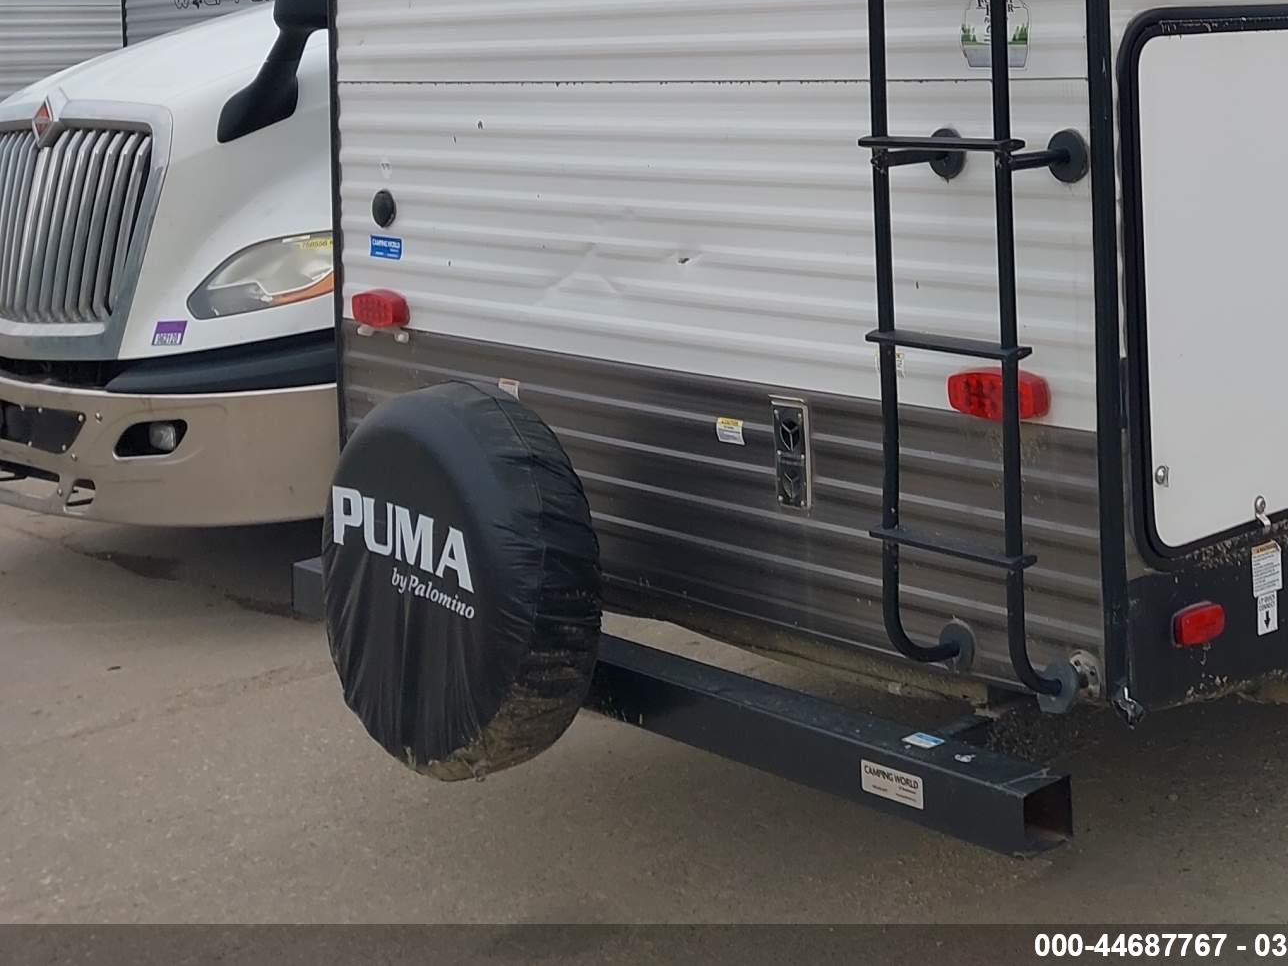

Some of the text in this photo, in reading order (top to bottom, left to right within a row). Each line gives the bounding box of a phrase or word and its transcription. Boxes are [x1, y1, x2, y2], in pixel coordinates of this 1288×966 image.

[332, 485, 474, 593] PUMA
[391, 567, 475, 619] by Palomino
[864, 765, 919, 789] CAMPING WORLD
